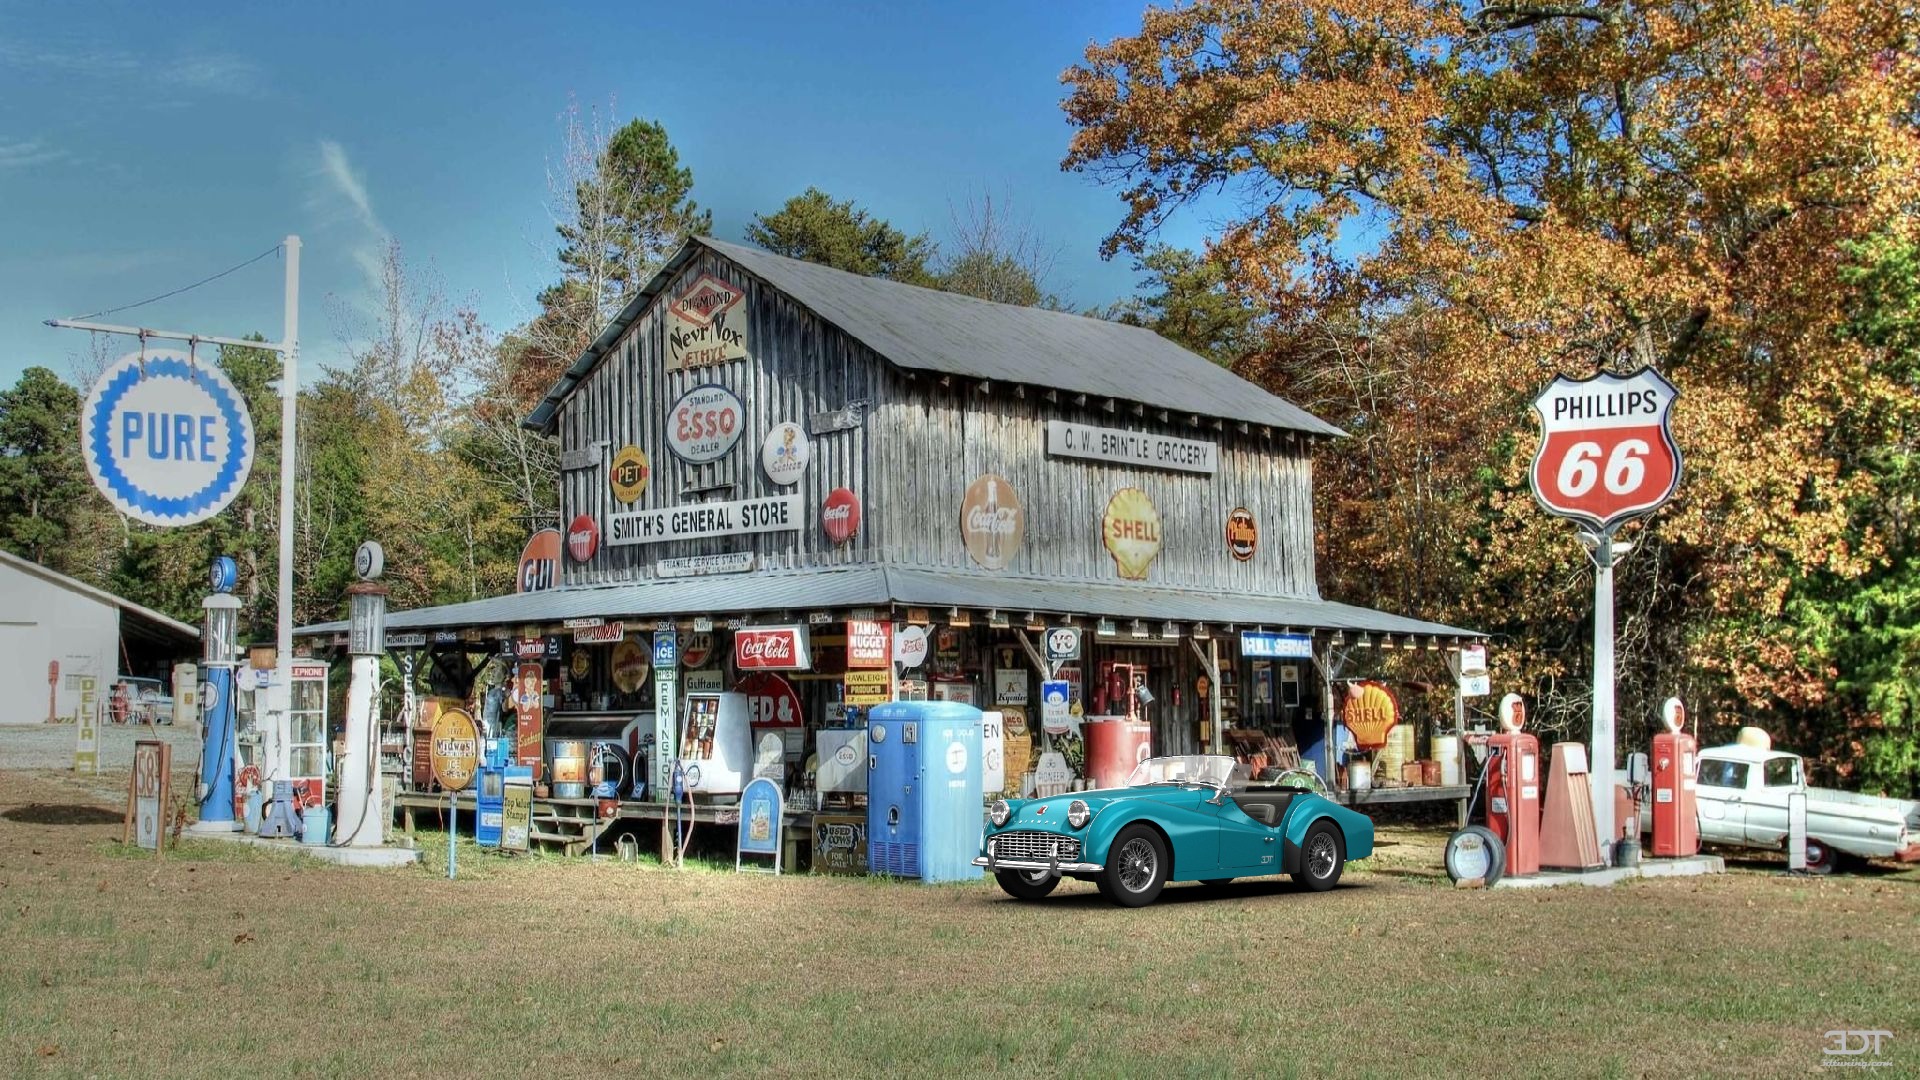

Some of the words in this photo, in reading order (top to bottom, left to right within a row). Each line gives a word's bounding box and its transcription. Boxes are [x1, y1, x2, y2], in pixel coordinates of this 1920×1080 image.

[682, 291, 731, 312] DIAMOND
[1554, 389, 1657, 421] PHILLIPS
[122, 411, 217, 462] PURE
[691, 442, 720, 455] DEALER
[1101, 434, 1149, 459] BRINTLE
[1157, 441, 1208, 467] GROCERY
[618, 465, 641, 483] PET
[1556, 438, 1650, 498] 66
[613, 514, 665, 540] SMITH'S
[671, 506, 733, 533] GENERAL
[741, 501, 789, 528] STORE
[1112, 519, 1158, 542] SHELL
[694, 556, 720, 568] SERVICE
[721, 554, 747, 564] STATION
[853, 622, 884, 636] TAMPA
[849, 636, 888, 649] NUGGET
[655, 646, 674, 660] ICE
[853, 648, 884, 658] CIGARS
[292, 667, 322, 676] EPHONE
[656, 668, 674, 681] TIRES
[81, 679, 95, 741] DELTA
[1347, 708, 1387, 723] SHELL
[403, 654, 413, 784] SERVICE
[661, 682, 670, 787] REMINGTON
[1038, 771, 1065, 780] PIONEER
[829, 827, 850, 836] USED
[828, 836, 852, 845] COWS
[831, 852, 844, 860] FOR
